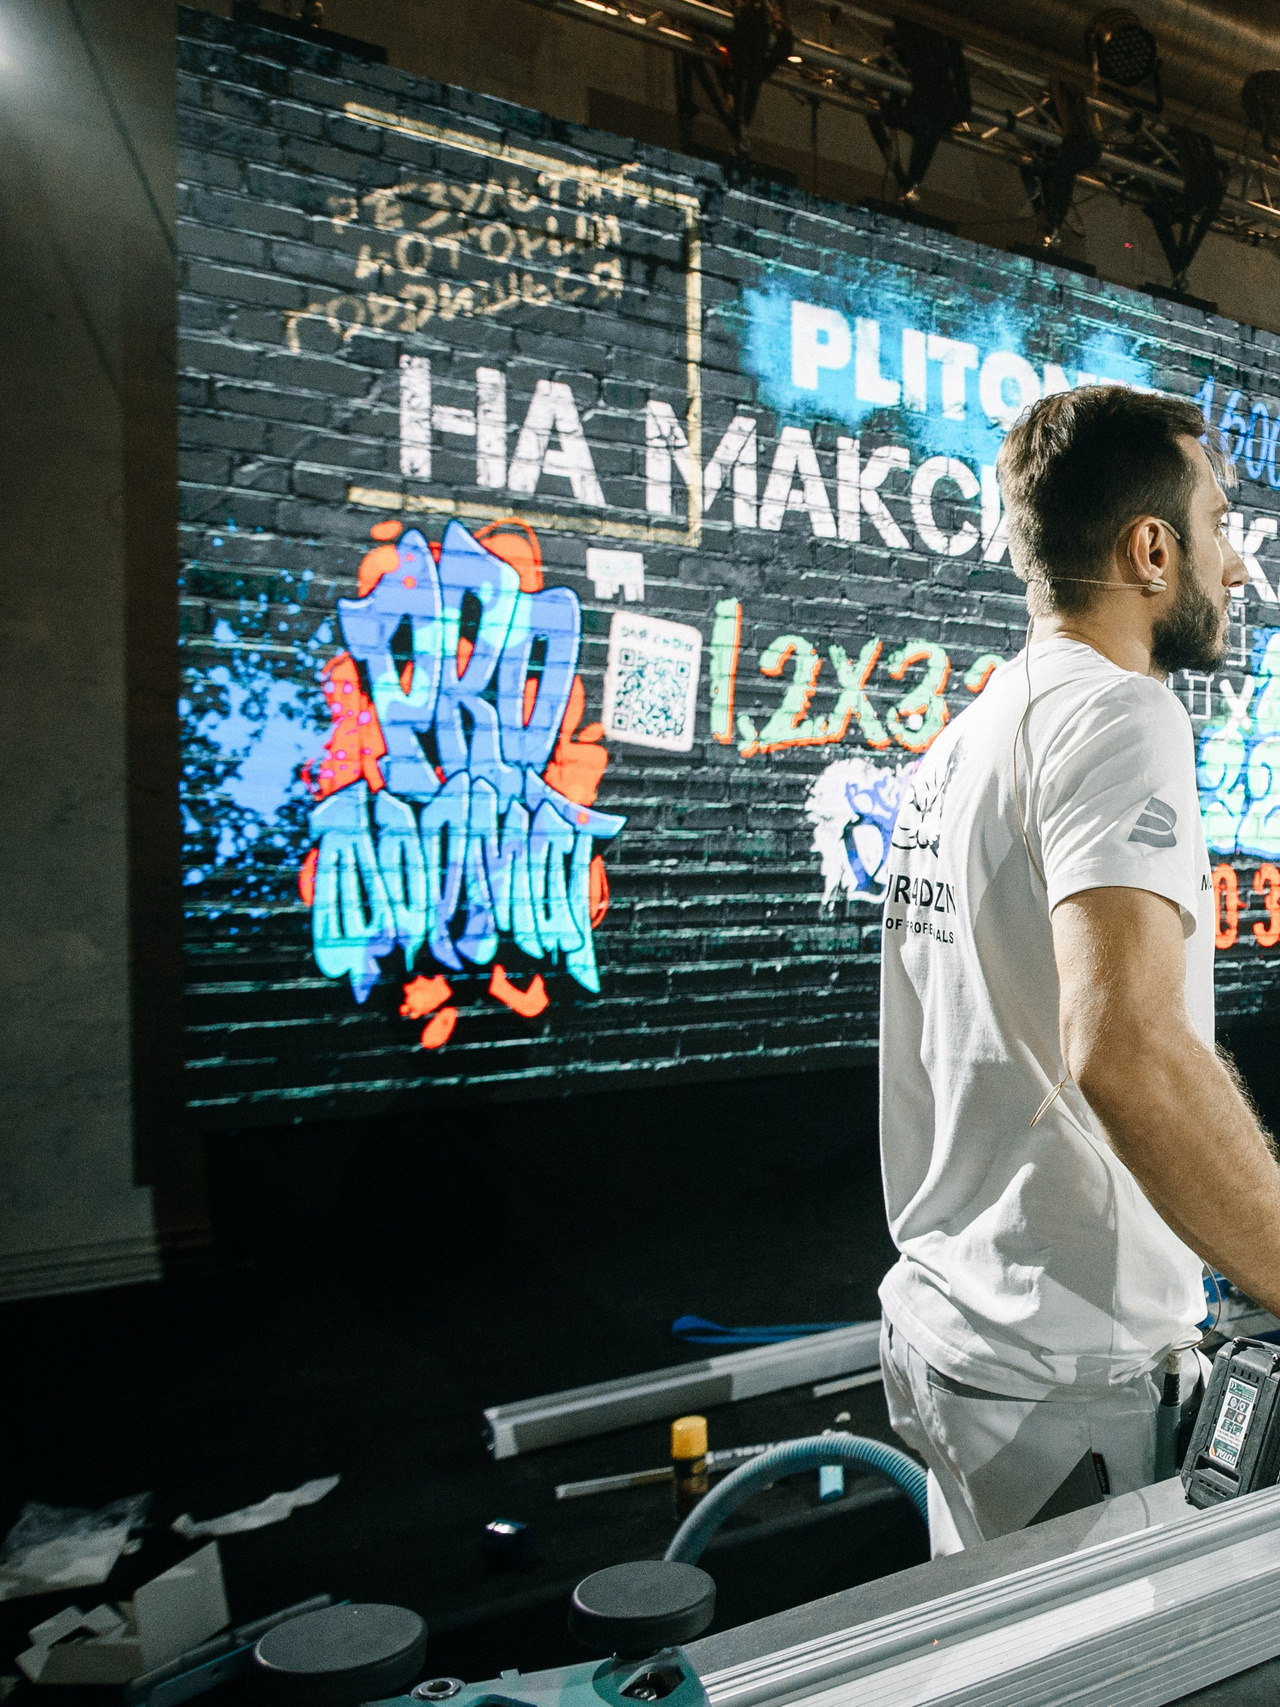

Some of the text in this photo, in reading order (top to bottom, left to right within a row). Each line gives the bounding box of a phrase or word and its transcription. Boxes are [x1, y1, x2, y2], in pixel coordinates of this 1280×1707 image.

[400, 354, 607, 507] НА
[886, 917, 903, 931] OF
[1216, 1448, 1236, 1463] TOTAL
